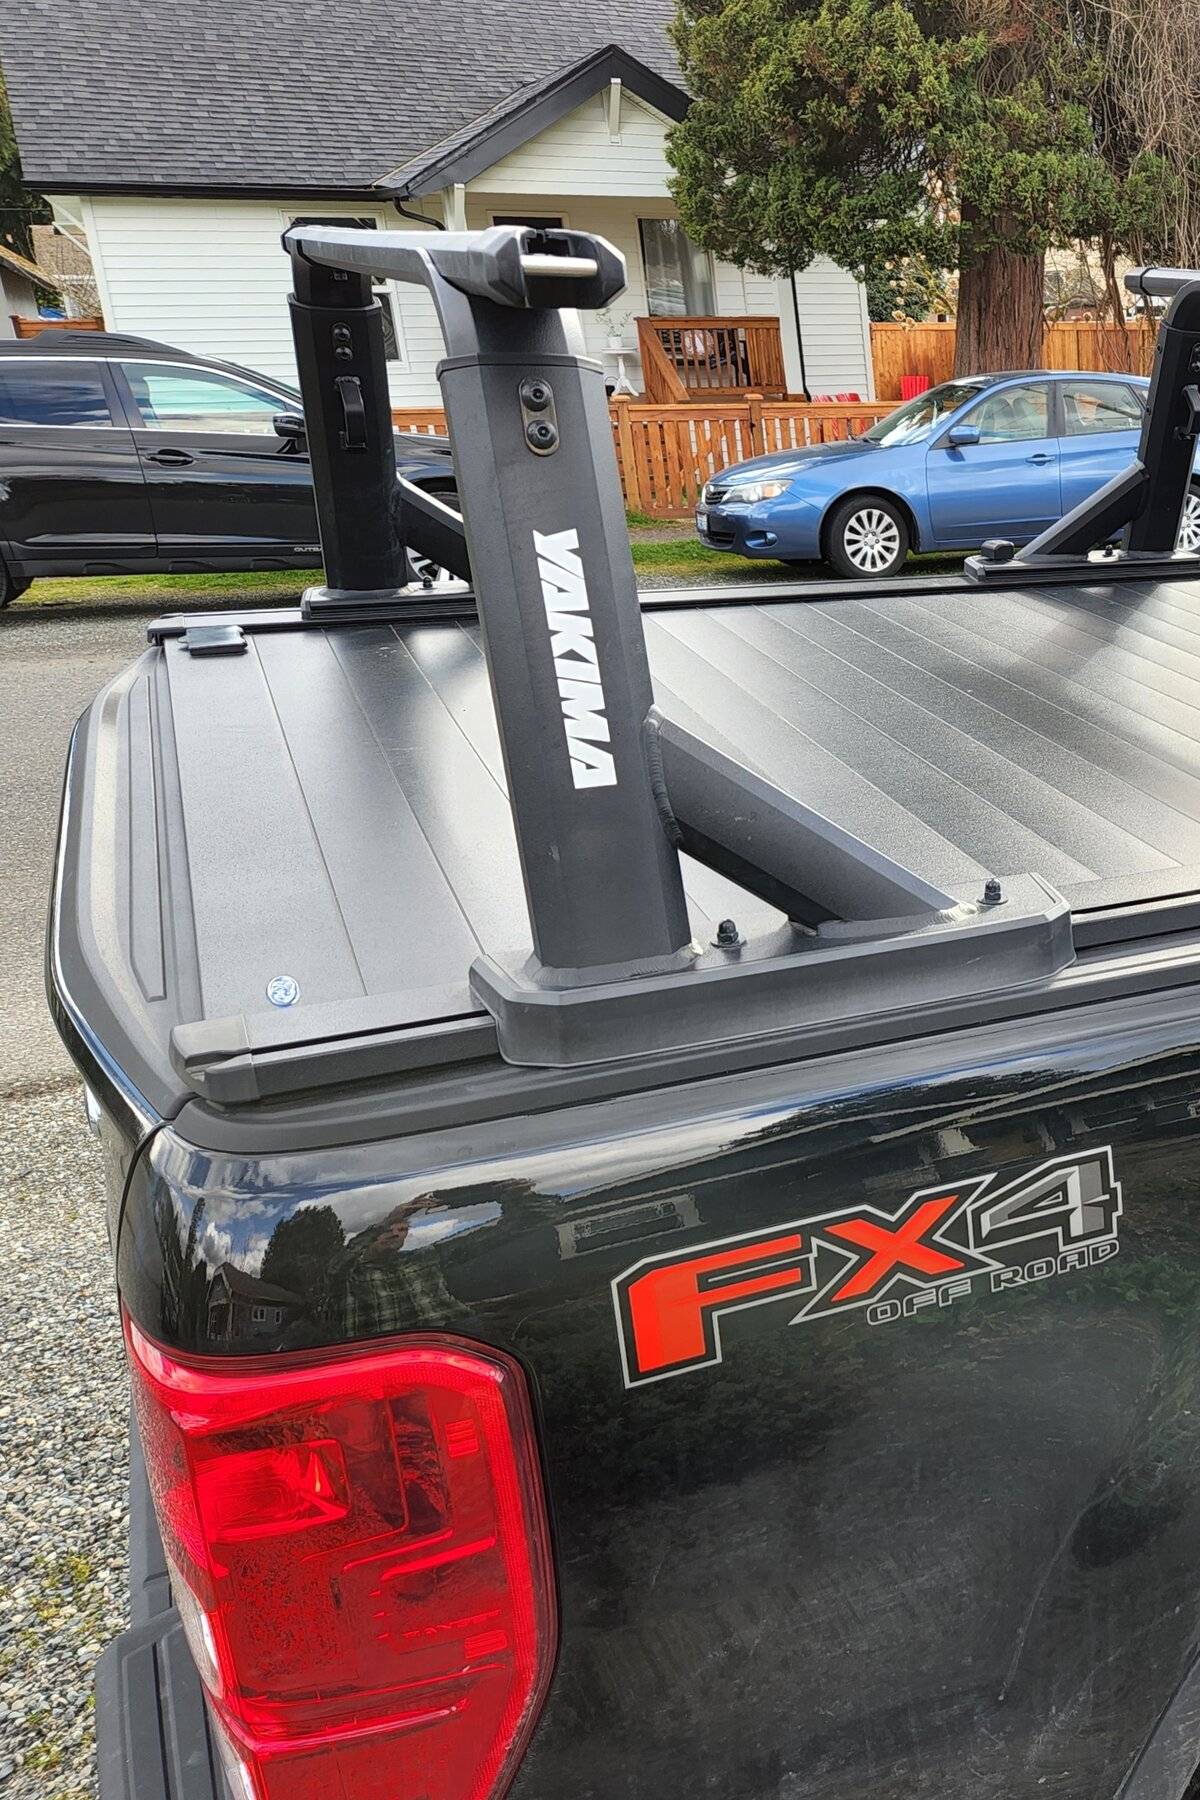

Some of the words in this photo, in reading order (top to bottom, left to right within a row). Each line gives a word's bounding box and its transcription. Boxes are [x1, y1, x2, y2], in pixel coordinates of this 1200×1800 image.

[533, 528, 617, 789] YAKIMA
[611, 1145, 1123, 1389] FX4
[867, 1278, 972, 1325] OFF
[990, 1240, 1119, 1292] ROAD
